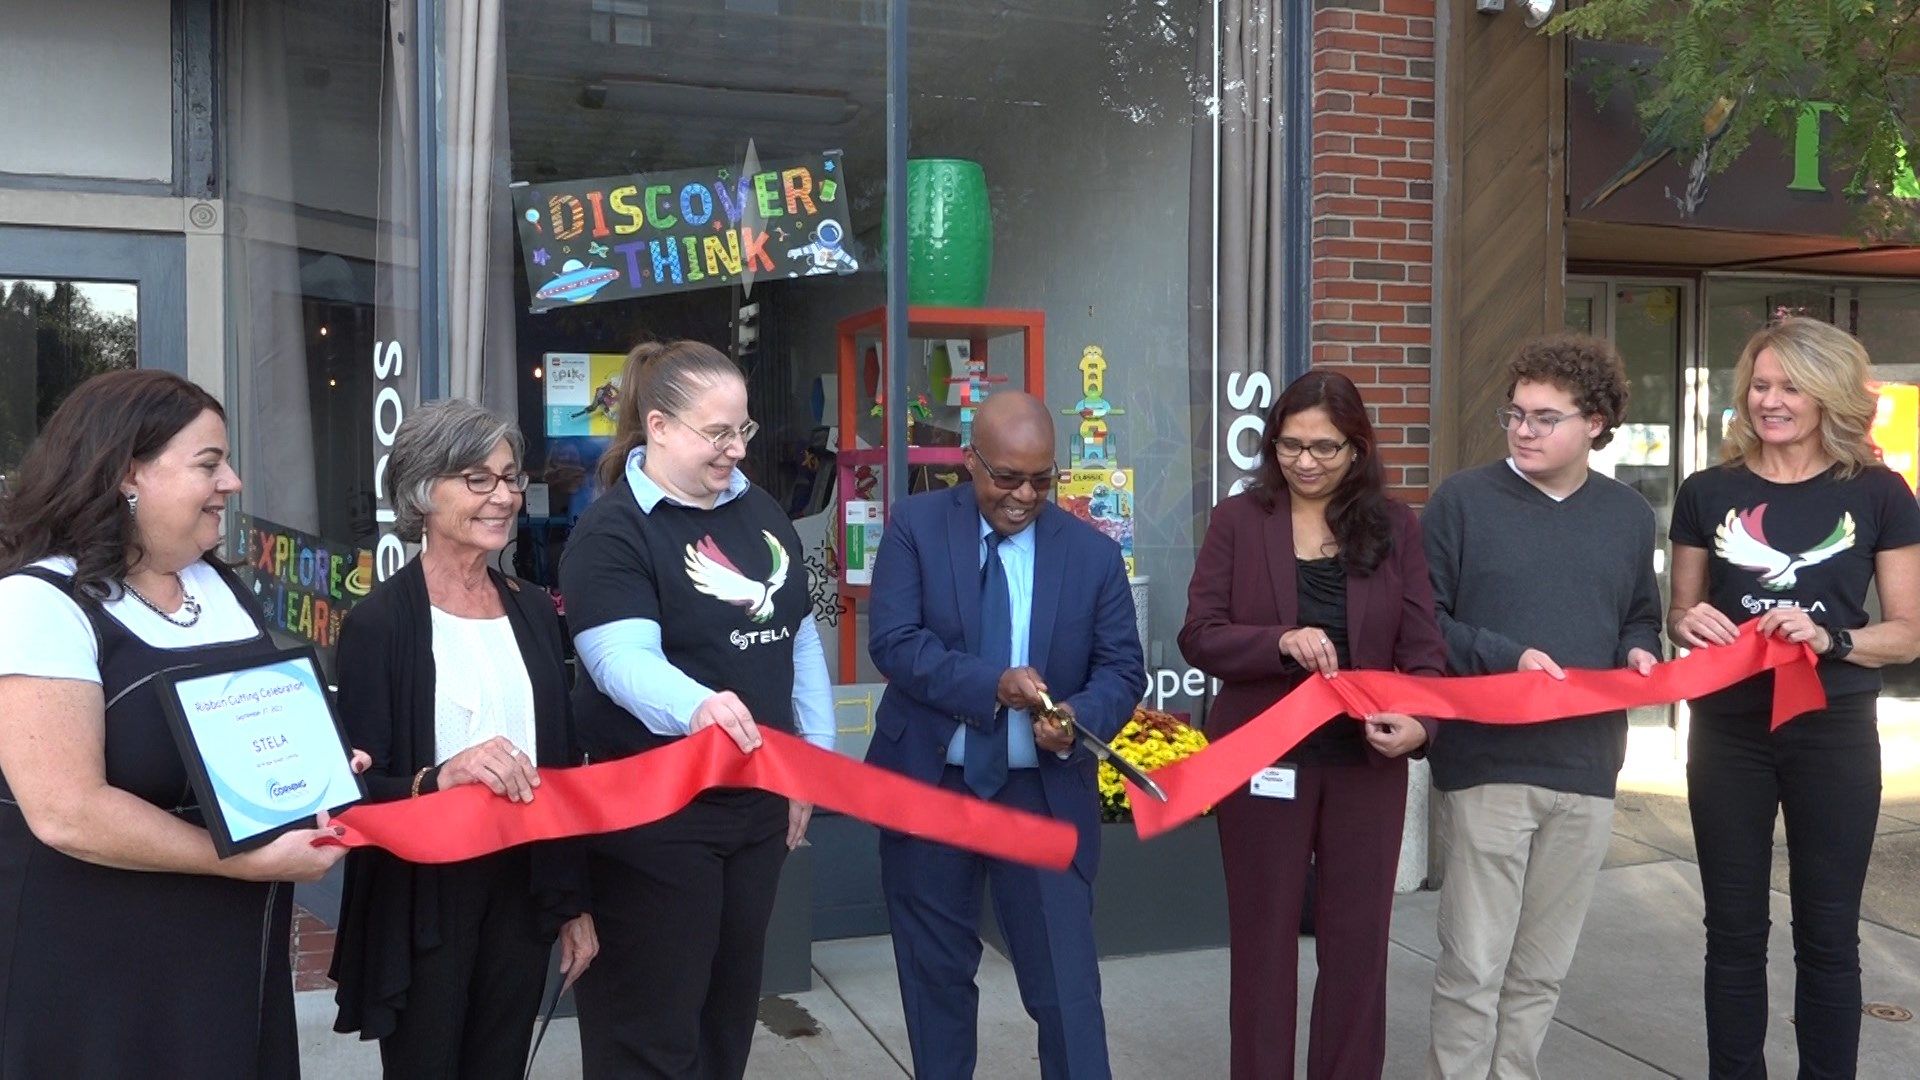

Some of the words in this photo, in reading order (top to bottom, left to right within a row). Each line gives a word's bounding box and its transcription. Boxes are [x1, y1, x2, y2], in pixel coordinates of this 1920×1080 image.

[549, 167, 817, 241] DISCOVER
[614, 227, 776, 290] THINK
[730, 626, 790, 650] STELA
[194, 699, 227, 712] Ribbon
[228, 692, 260, 706] Cutting
[259, 680, 305, 698] Celebration
[252, 734, 288, 753] STELA
